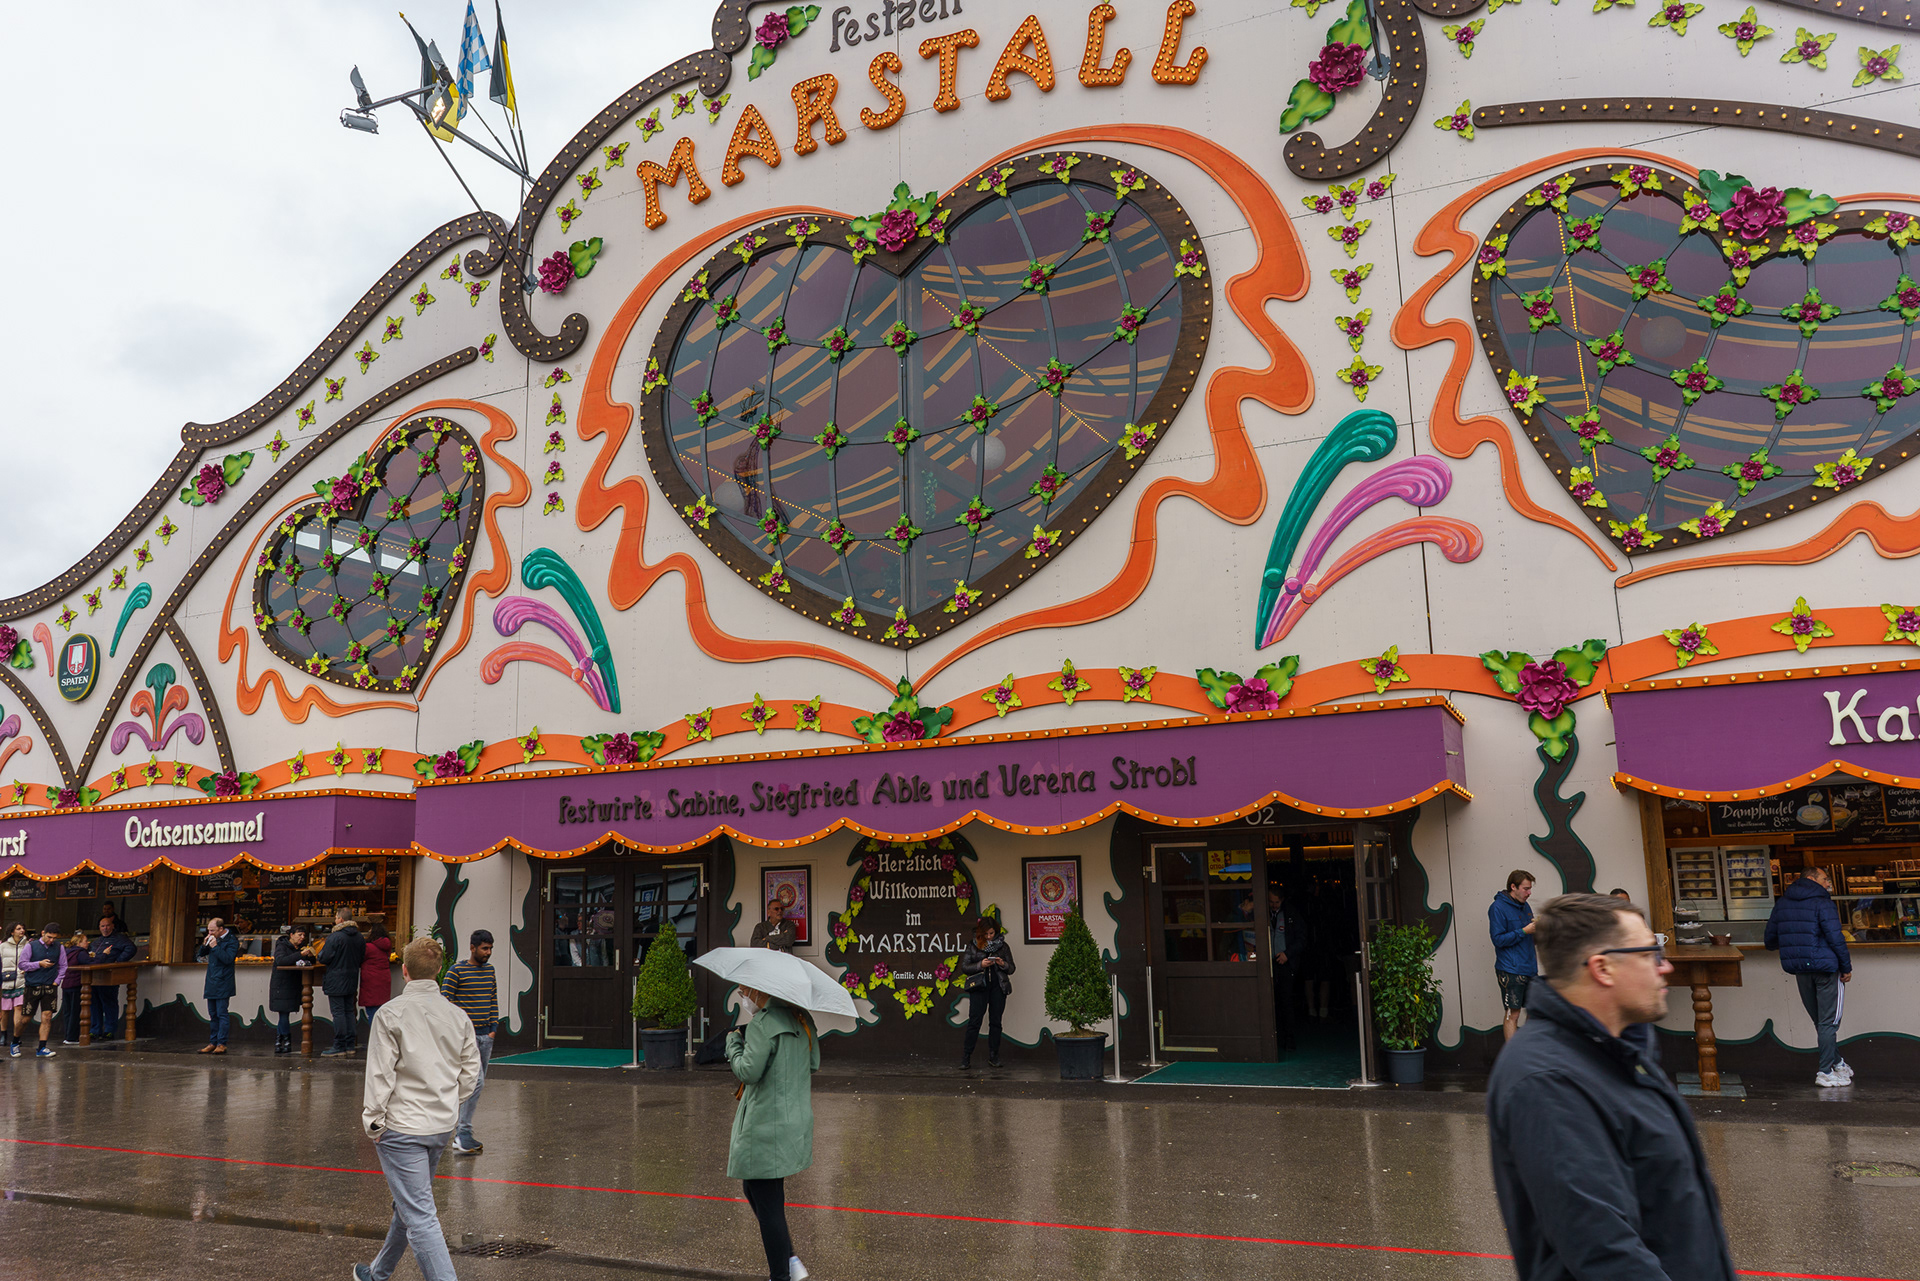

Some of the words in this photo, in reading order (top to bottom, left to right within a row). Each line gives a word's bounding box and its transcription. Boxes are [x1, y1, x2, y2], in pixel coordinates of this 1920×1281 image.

[636, 0, 1209, 230] MARSTALL
[61, 675, 89, 687] SPATEN
[1823, 688, 1920, 746] Ka
[665, 788, 745, 817] Sabine,
[750, 778, 859, 816] Siegfried
[871, 771, 932, 804] Able
[942, 770, 990, 800] und
[998, 763, 1096, 797] Verena
[1110, 755, 1197, 790] Strobl
[1719, 800, 1794, 820] Dampfnudel
[124, 811, 265, 848] Ochsensemmel
[877, 853, 942, 873] Herzlich
[869, 880, 957, 900] Willkommen
[905, 909, 922, 926] im
[1038, 914, 1066, 922] MARSTAL
[858, 932, 967, 953] MARSTALL
[917, 970, 933, 980] Able
